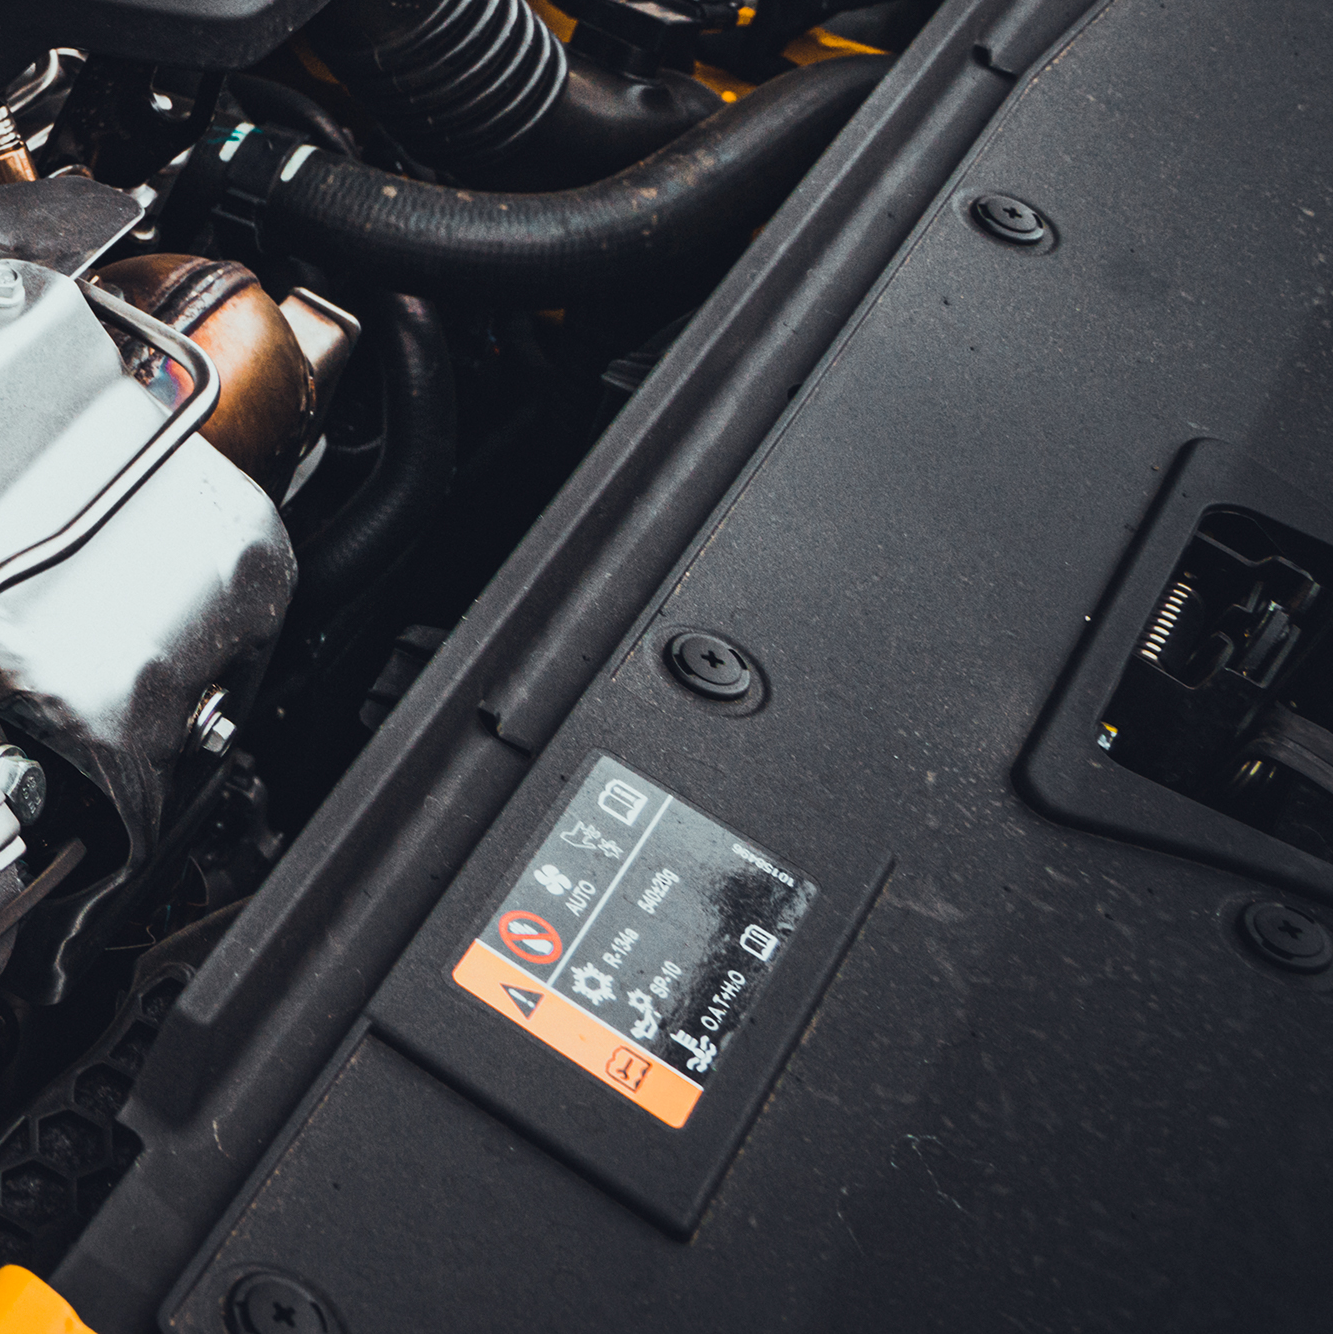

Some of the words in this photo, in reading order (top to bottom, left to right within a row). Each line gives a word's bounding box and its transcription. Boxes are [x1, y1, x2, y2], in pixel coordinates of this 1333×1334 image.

[565, 879, 596, 917] AUTO
[602, 927, 640, 969] R-134a
[637, 868, 680, 915] 540±20g
[649, 961, 683, 999] SP-10
